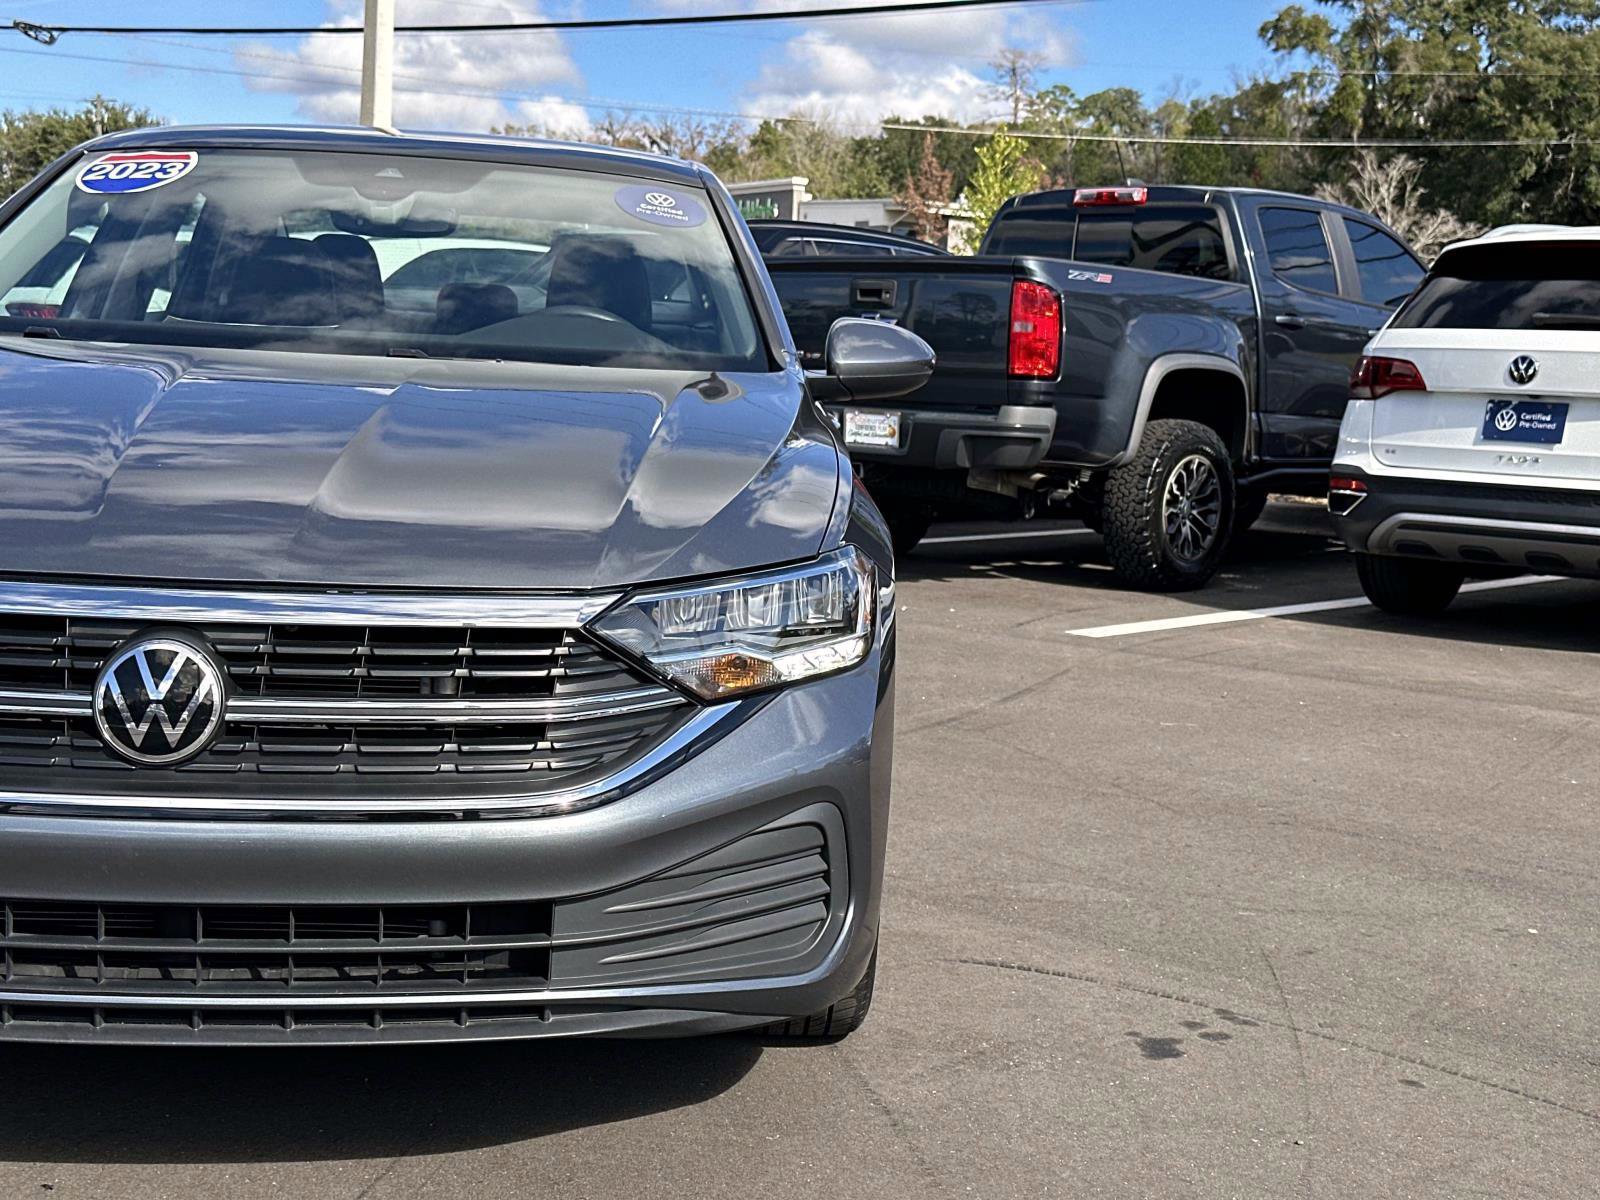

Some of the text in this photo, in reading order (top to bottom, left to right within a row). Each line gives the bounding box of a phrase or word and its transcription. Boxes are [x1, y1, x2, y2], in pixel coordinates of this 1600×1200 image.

[82, 162, 185, 181] 2023
[636, 208, 689, 221] Pre-Owned
[639, 203, 684, 215] Certified
[1521, 412, 1552, 422] Certified
[1519, 421, 1557, 430] Pre-Owned
